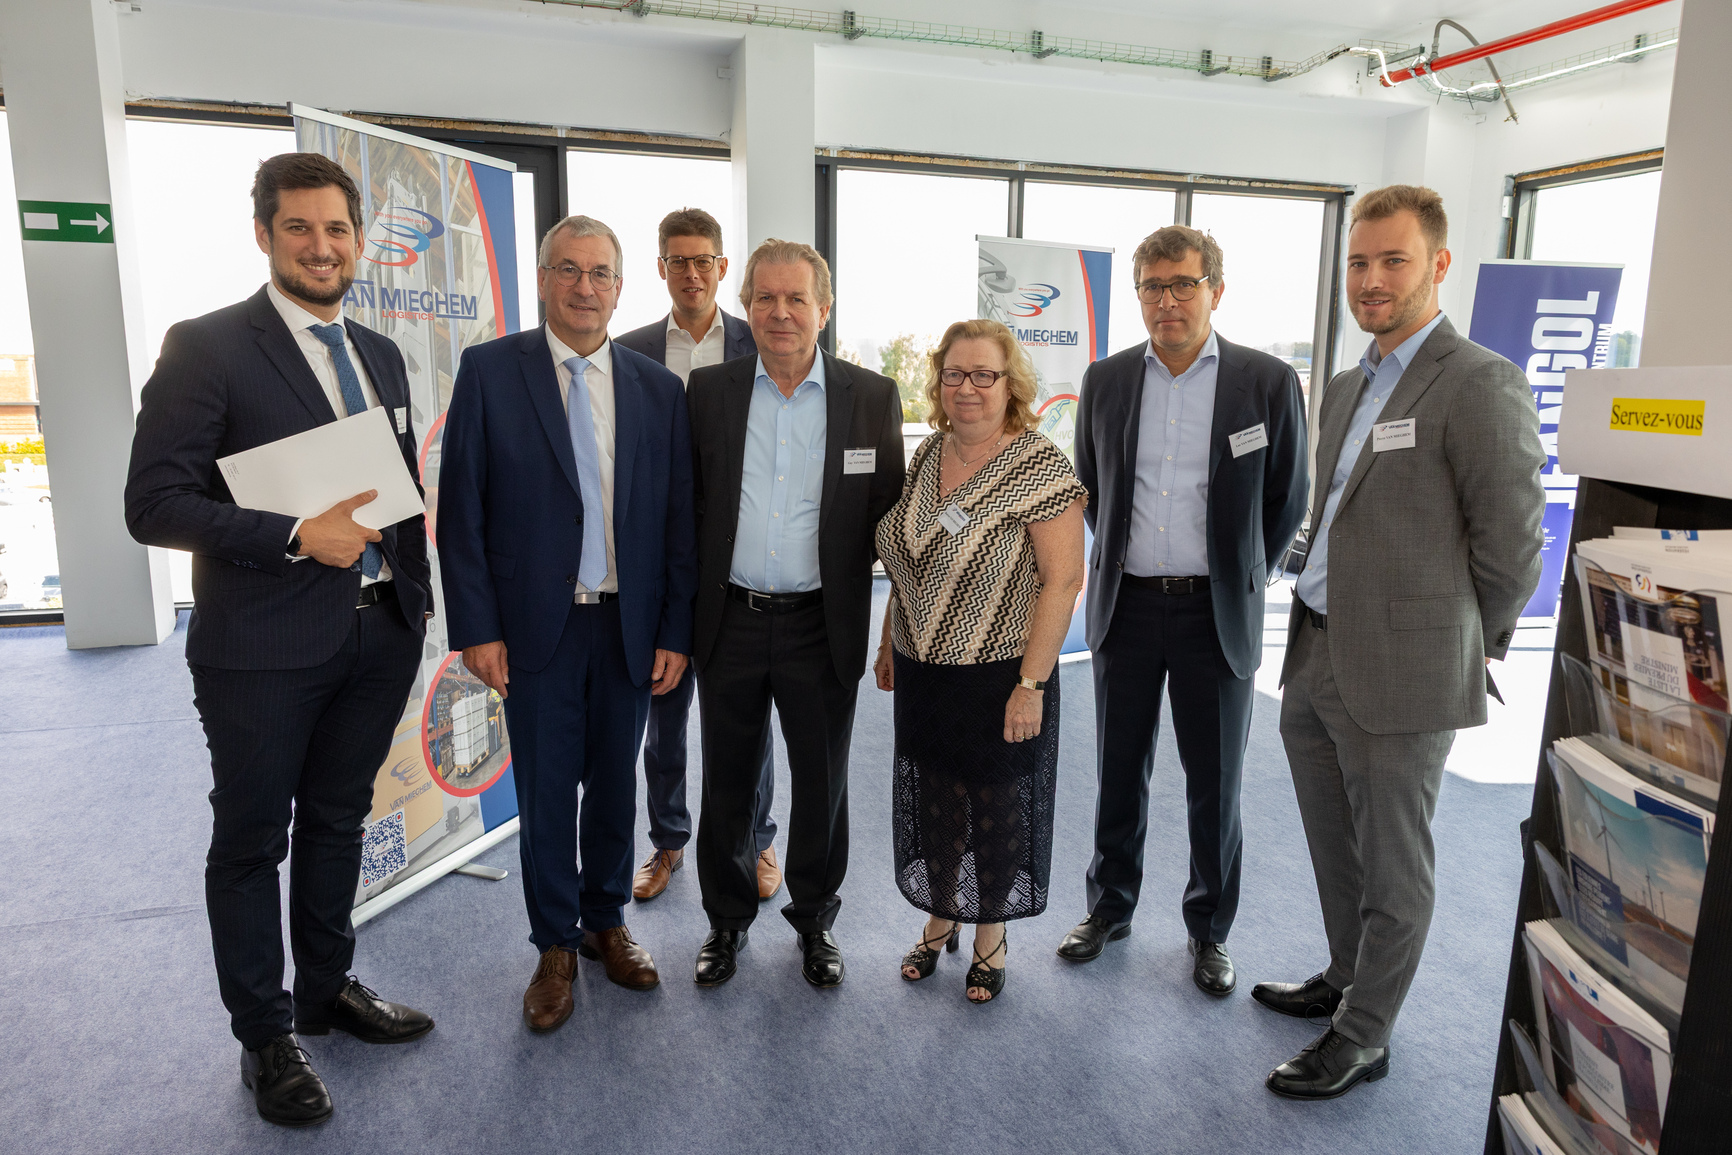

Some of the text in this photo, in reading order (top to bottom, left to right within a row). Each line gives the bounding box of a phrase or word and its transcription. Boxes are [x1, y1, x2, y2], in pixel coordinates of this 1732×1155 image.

[342, 284, 477, 316] AN MIEGHEM
[382, 310, 435, 320] LOGISTICS
[1017, 328, 1079, 344] MIEGHEM
[1611, 404, 1703, 430] Servez-vous
[1055, 429, 1075, 441] HVO
[1633, 661, 1679, 686] DU PREMIER
[1641, 654, 1679, 675] MINISTRE
[1648, 677, 1681, 696] LA LISTE
[390, 796, 405, 811] VAN
[405, 780, 432, 802] MIEGHEM
